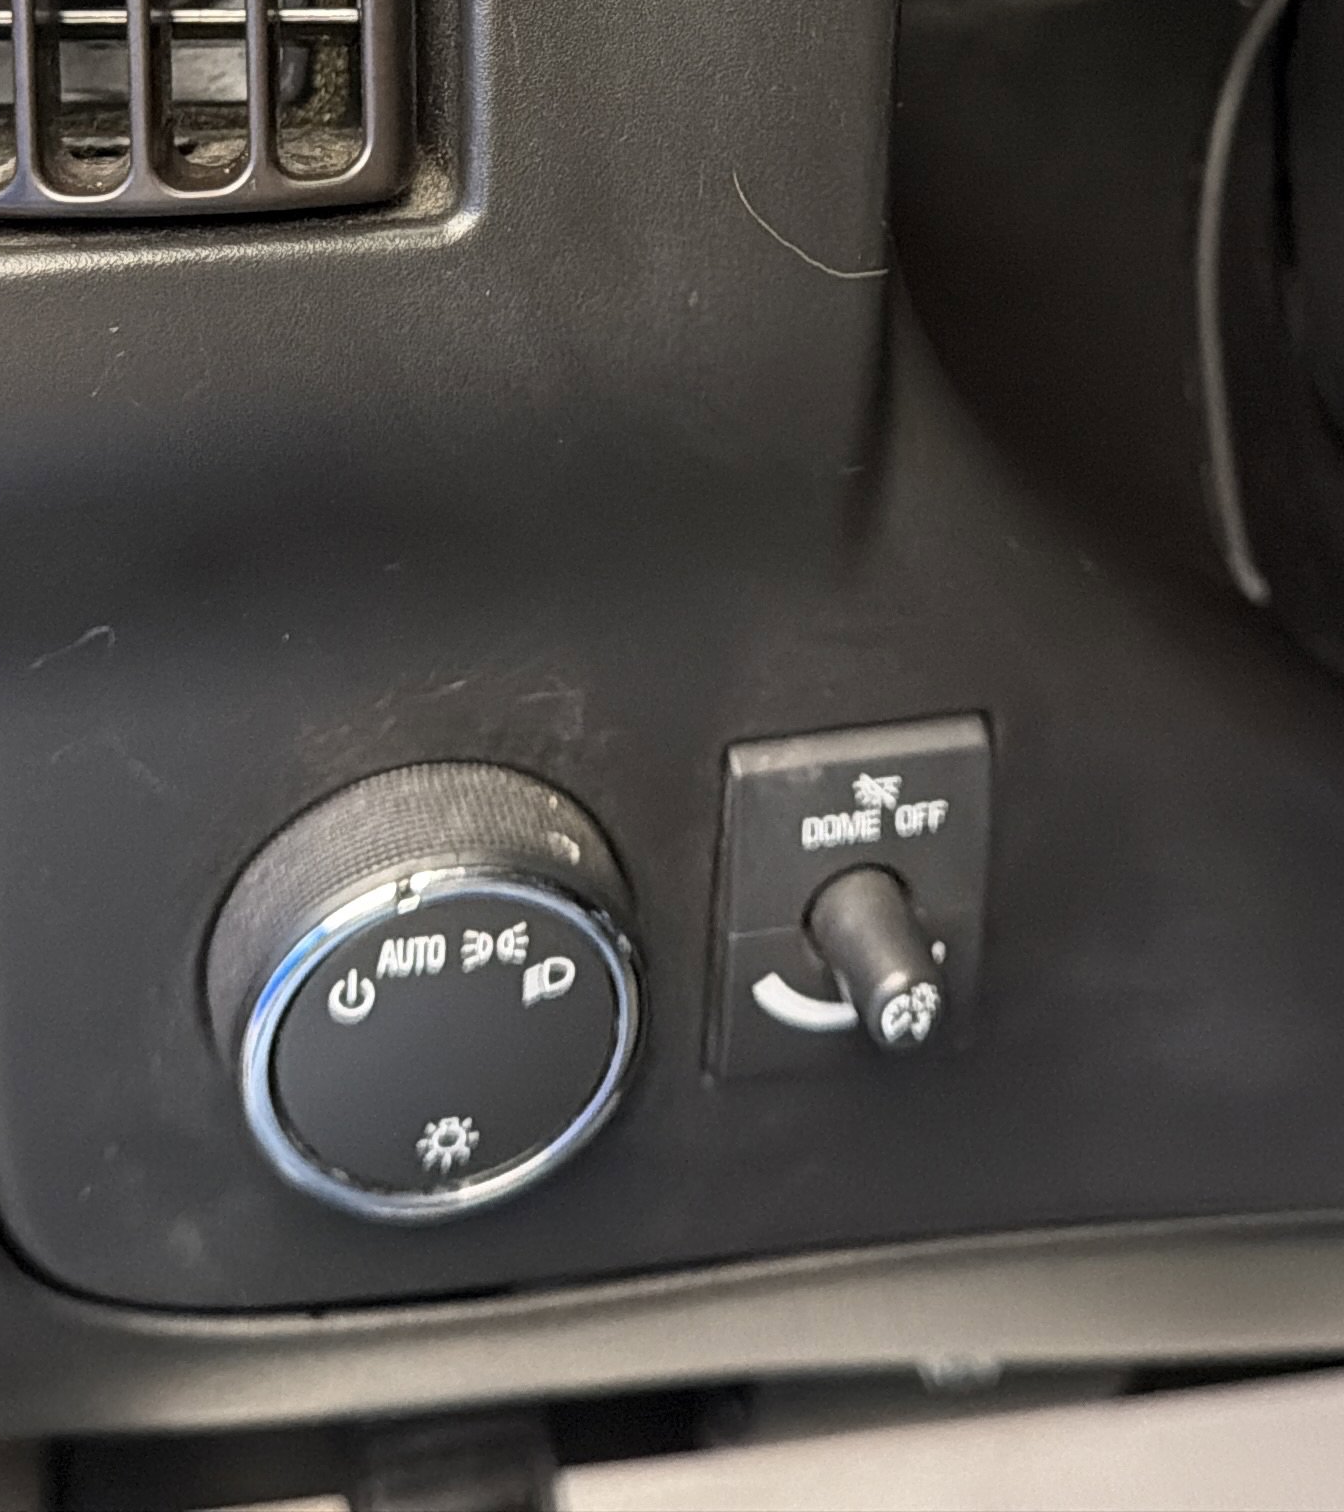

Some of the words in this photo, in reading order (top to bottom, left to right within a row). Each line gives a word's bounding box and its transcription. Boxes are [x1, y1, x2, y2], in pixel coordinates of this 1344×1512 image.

[801, 808, 881, 851] DOME
[894, 798, 949, 838] OFF
[375, 934, 447, 979] AUTO
